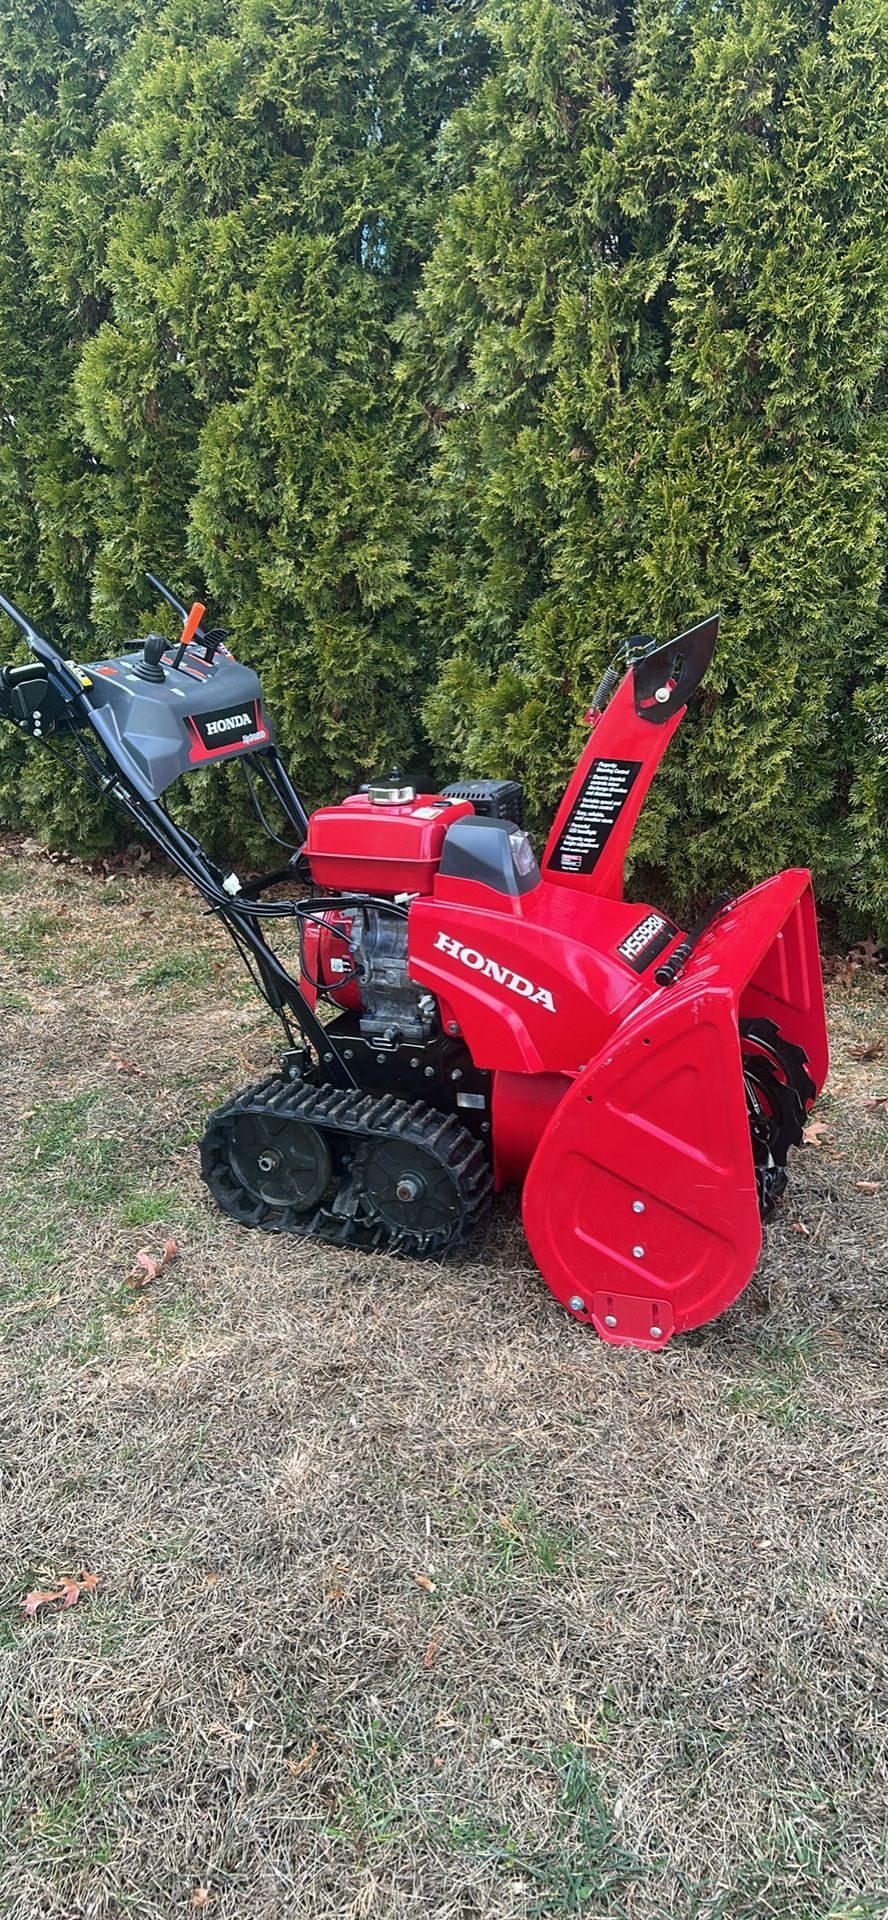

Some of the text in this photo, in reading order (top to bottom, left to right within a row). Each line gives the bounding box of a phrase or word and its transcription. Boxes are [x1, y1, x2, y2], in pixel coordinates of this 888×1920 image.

[205, 713, 253, 736] HONDA
[618, 913, 667, 960] HSS928A
[433, 931, 557, 1013] HONDA
